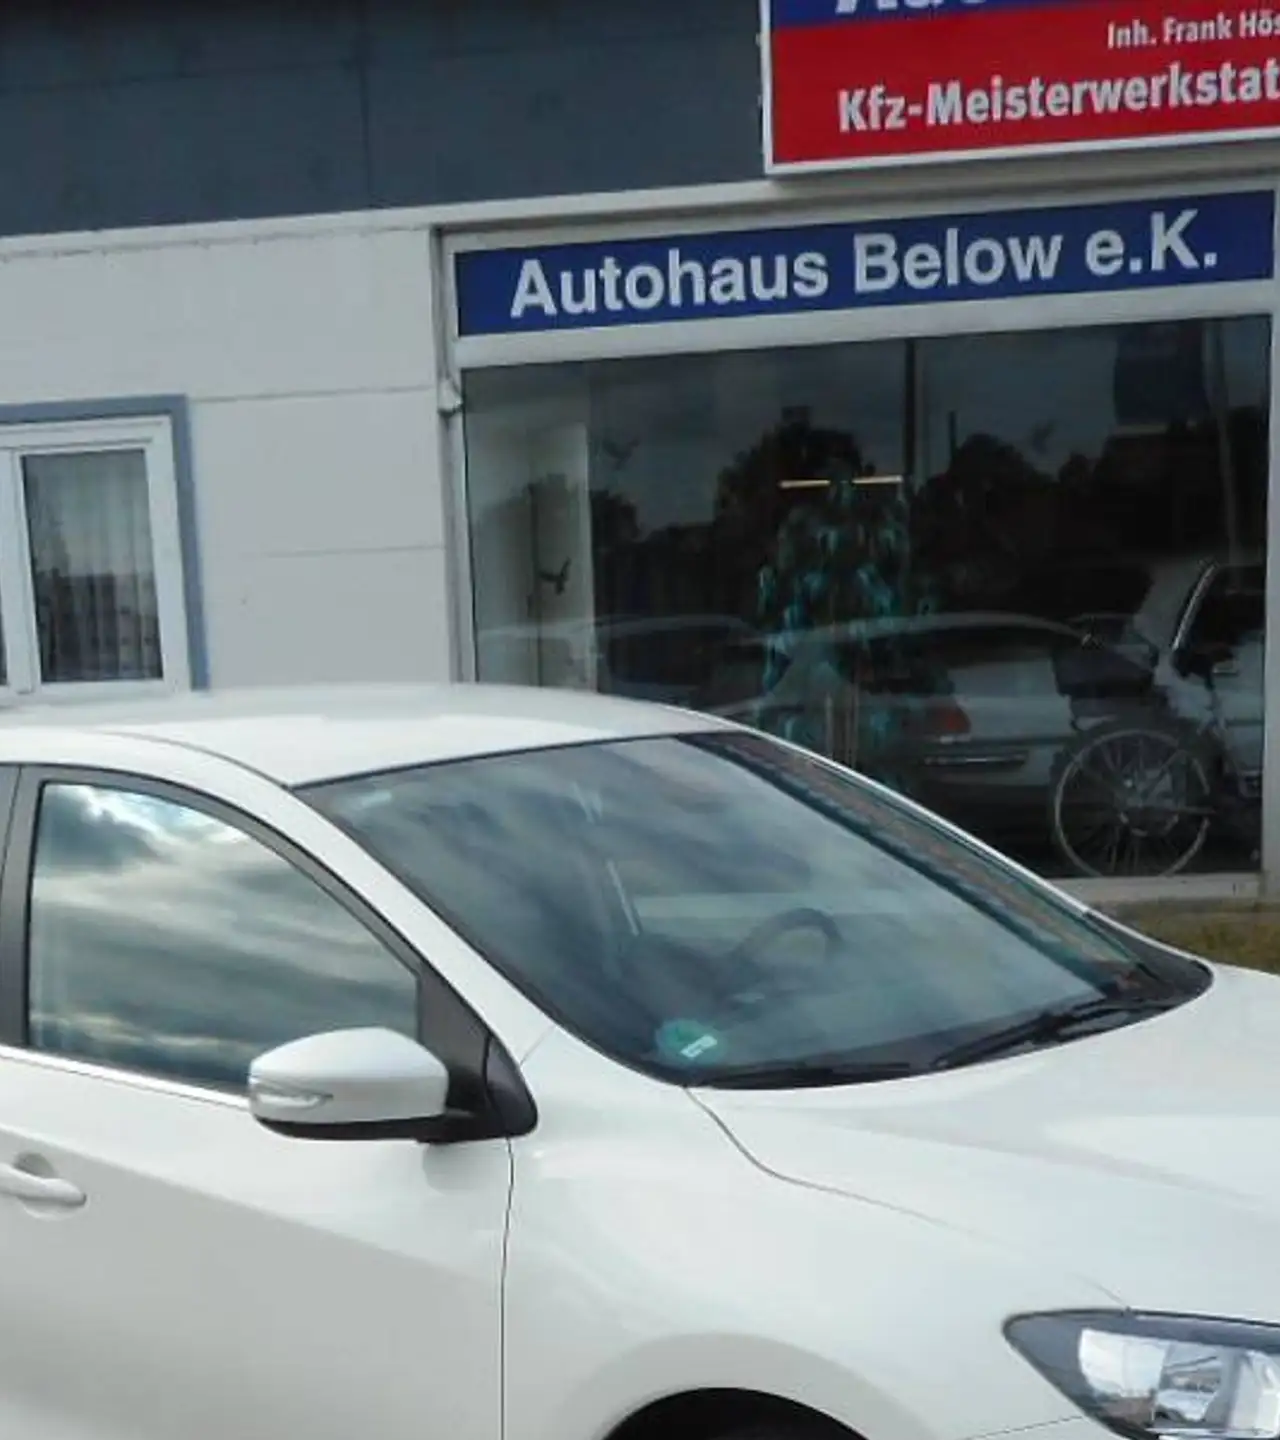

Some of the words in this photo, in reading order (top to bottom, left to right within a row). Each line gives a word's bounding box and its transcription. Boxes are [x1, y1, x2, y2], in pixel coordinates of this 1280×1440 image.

[1107, 19, 1157, 49] Inh.
[1162, 12, 1233, 44] Frank
[510, 247, 829, 318] Autohaus
[852, 228, 1063, 294] Below
[1085, 208, 1219, 276] e.K.
